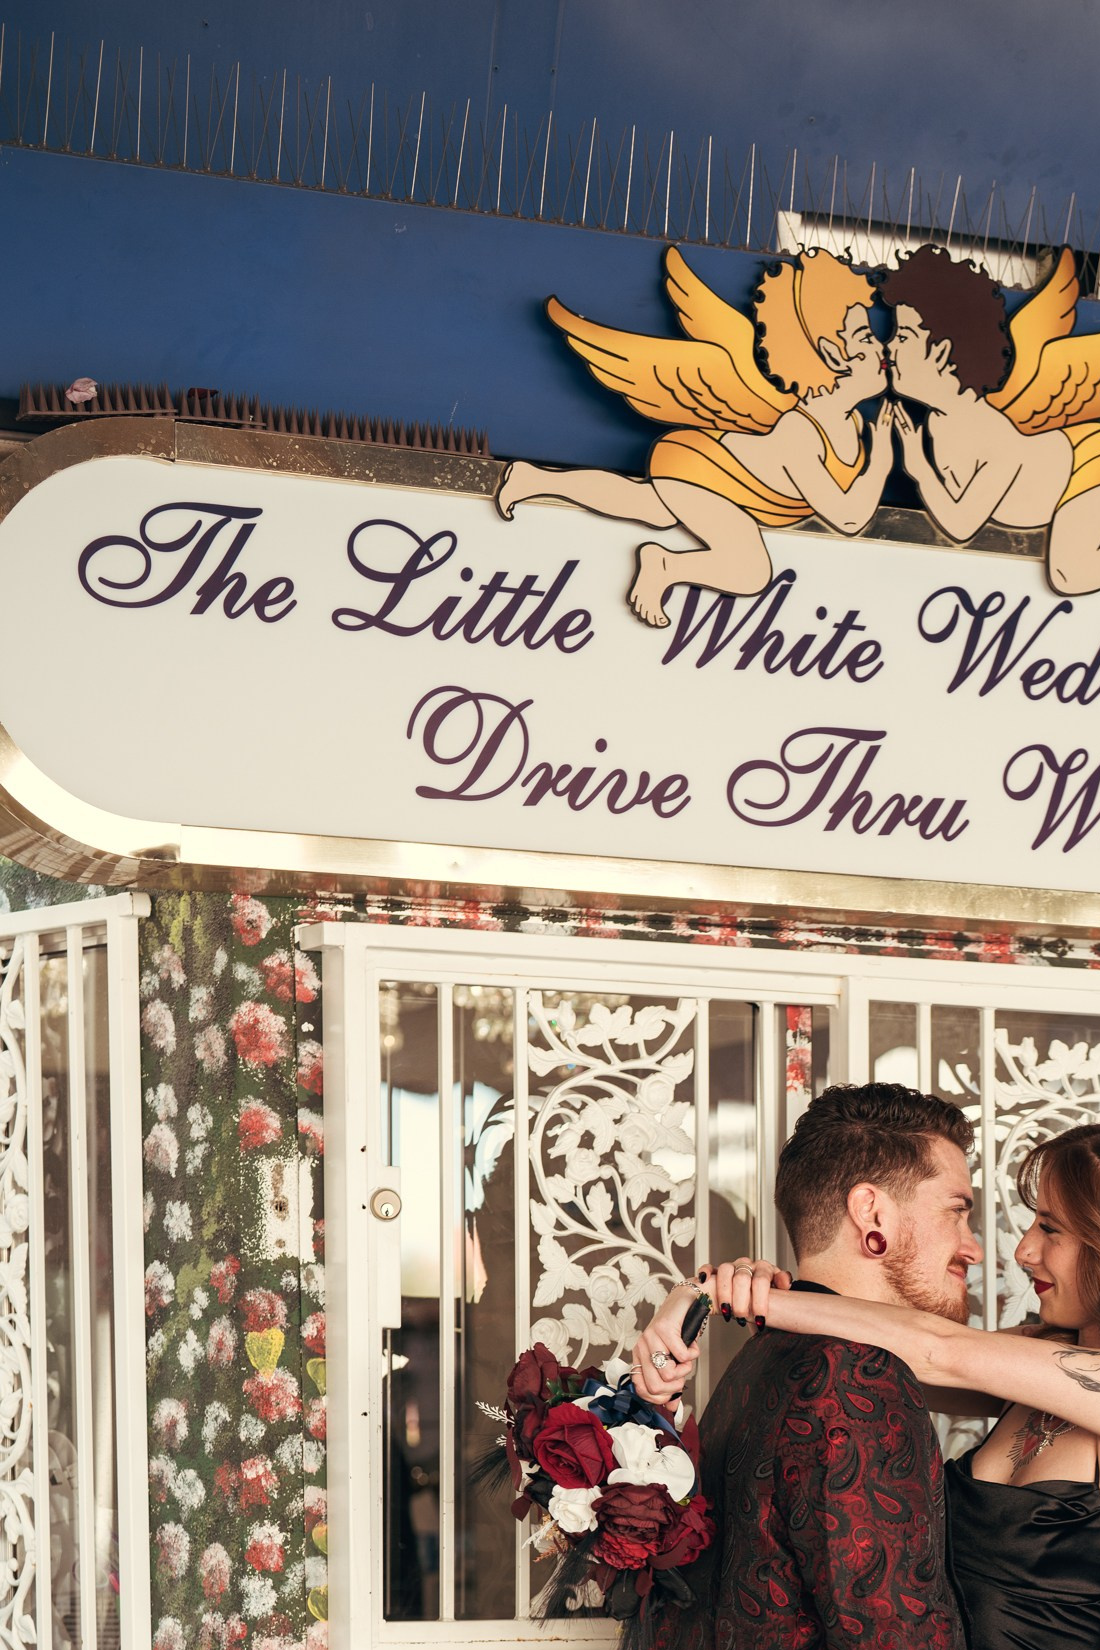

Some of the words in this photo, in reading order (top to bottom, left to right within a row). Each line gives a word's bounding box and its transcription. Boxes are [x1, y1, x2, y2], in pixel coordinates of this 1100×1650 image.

[77, 502, 297, 624] The
[332, 518, 595, 654] Little
[660, 569, 885, 683] White
[406, 684, 692, 819] Drive
[726, 726, 969, 842] Thru
